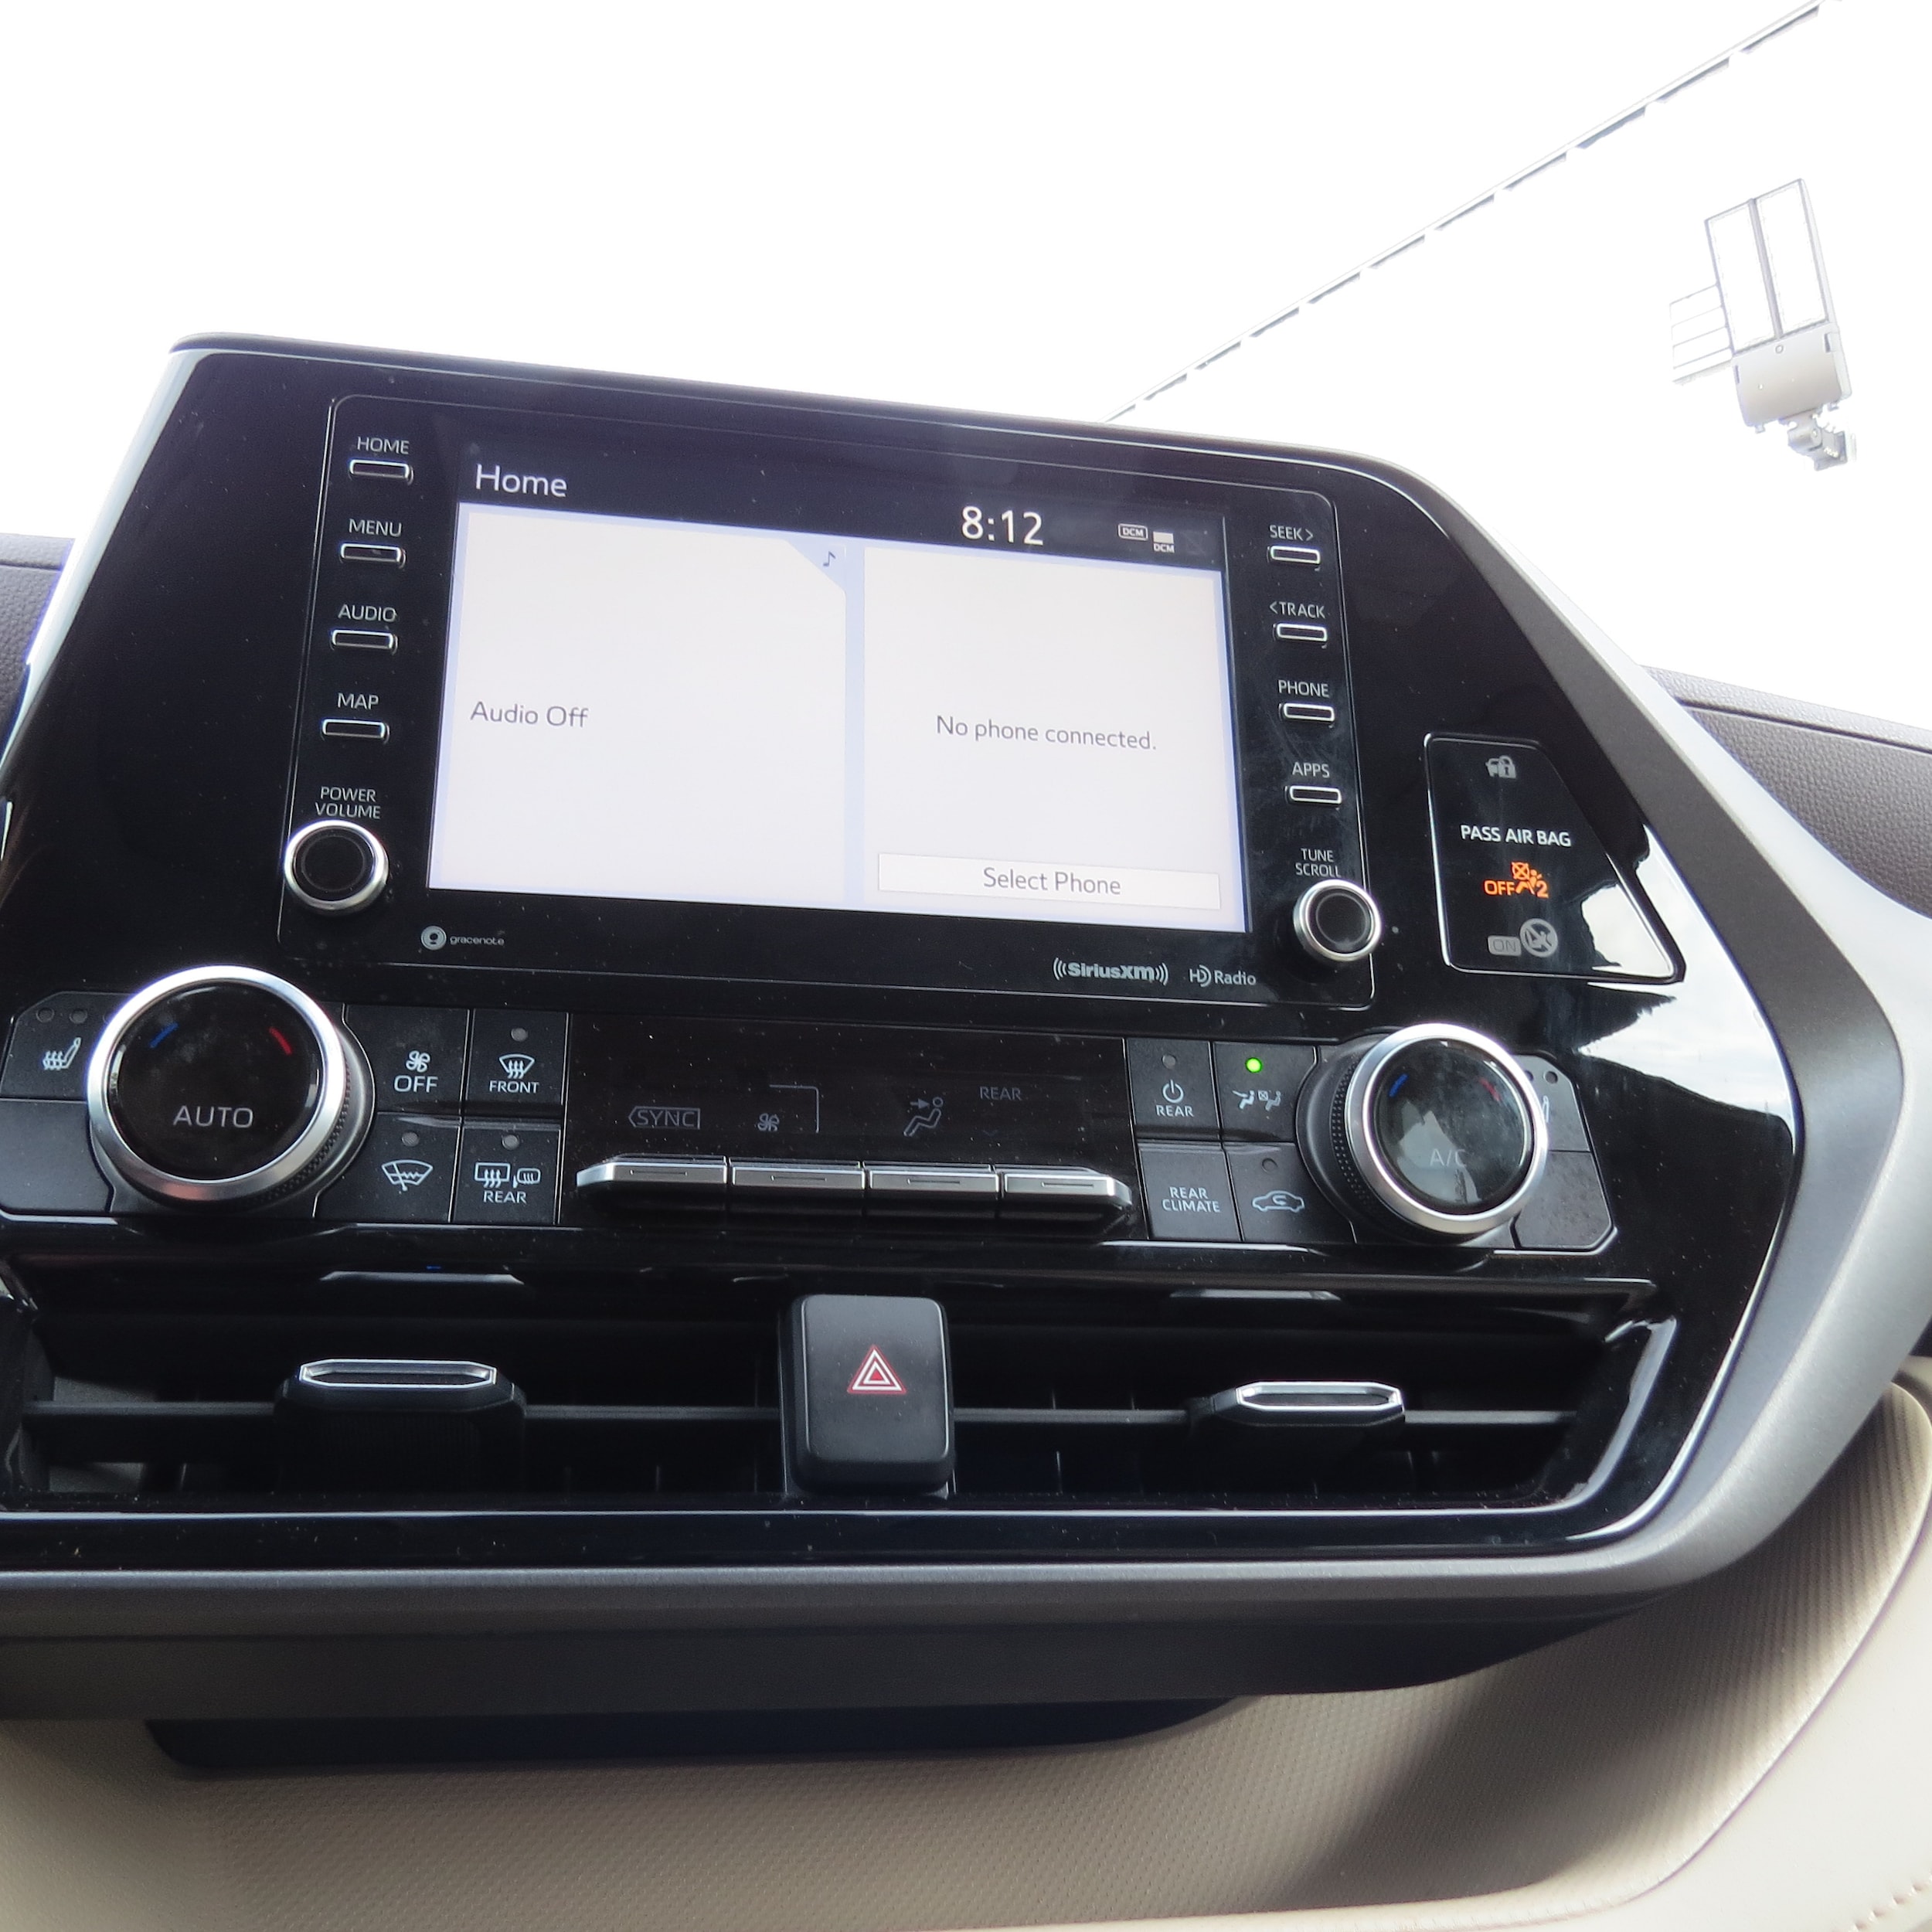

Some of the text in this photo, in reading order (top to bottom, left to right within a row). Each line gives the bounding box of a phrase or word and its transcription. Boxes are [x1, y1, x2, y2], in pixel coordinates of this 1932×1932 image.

[357, 436, 410, 454] HOME
[474, 463, 568, 498] Home
[349, 519, 403, 538] MENU
[961, 505, 1044, 546] 8:12
[1121, 526, 1145, 538] DCM
[1153, 543, 1175, 553] DCM
[338, 604, 398, 623] AUDIO
[1278, 679, 1329, 698] PHONE
[337, 692, 379, 710] MAP
[470, 700, 589, 729] Audio Off
[936, 715, 1157, 750] No phone connected.
[1292, 761, 1330, 778] APPS
[320, 786, 376, 803] POWER
[315, 802, 381, 819] VOLUME
[1461, 824, 1572, 848] PASS AIR BAG
[1301, 848, 1335, 862] TUNE
[1294, 862, 1342, 878] SCROLL
[982, 867, 1121, 895] Select Phone
[1484, 879, 1515, 896] OFF
[449, 935, 505, 947] gracenote
[1492, 937, 1518, 953] ON
[1214, 969, 1257, 986] Radio
[393, 1075, 439, 1094] OFF
[488, 1080, 539, 1094] FRONT
[978, 1086, 1022, 1102] REAR
[172, 1107, 254, 1129] AUTO
[635, 1110, 696, 1129] SYNC
[1155, 1105, 1194, 1118] REAR
[1429, 1148, 1468, 1169] A/C
[482, 1190, 528, 1205] REAR
[1169, 1186, 1208, 1199] REAR
[1162, 1197, 1221, 1214] CLIMATE
